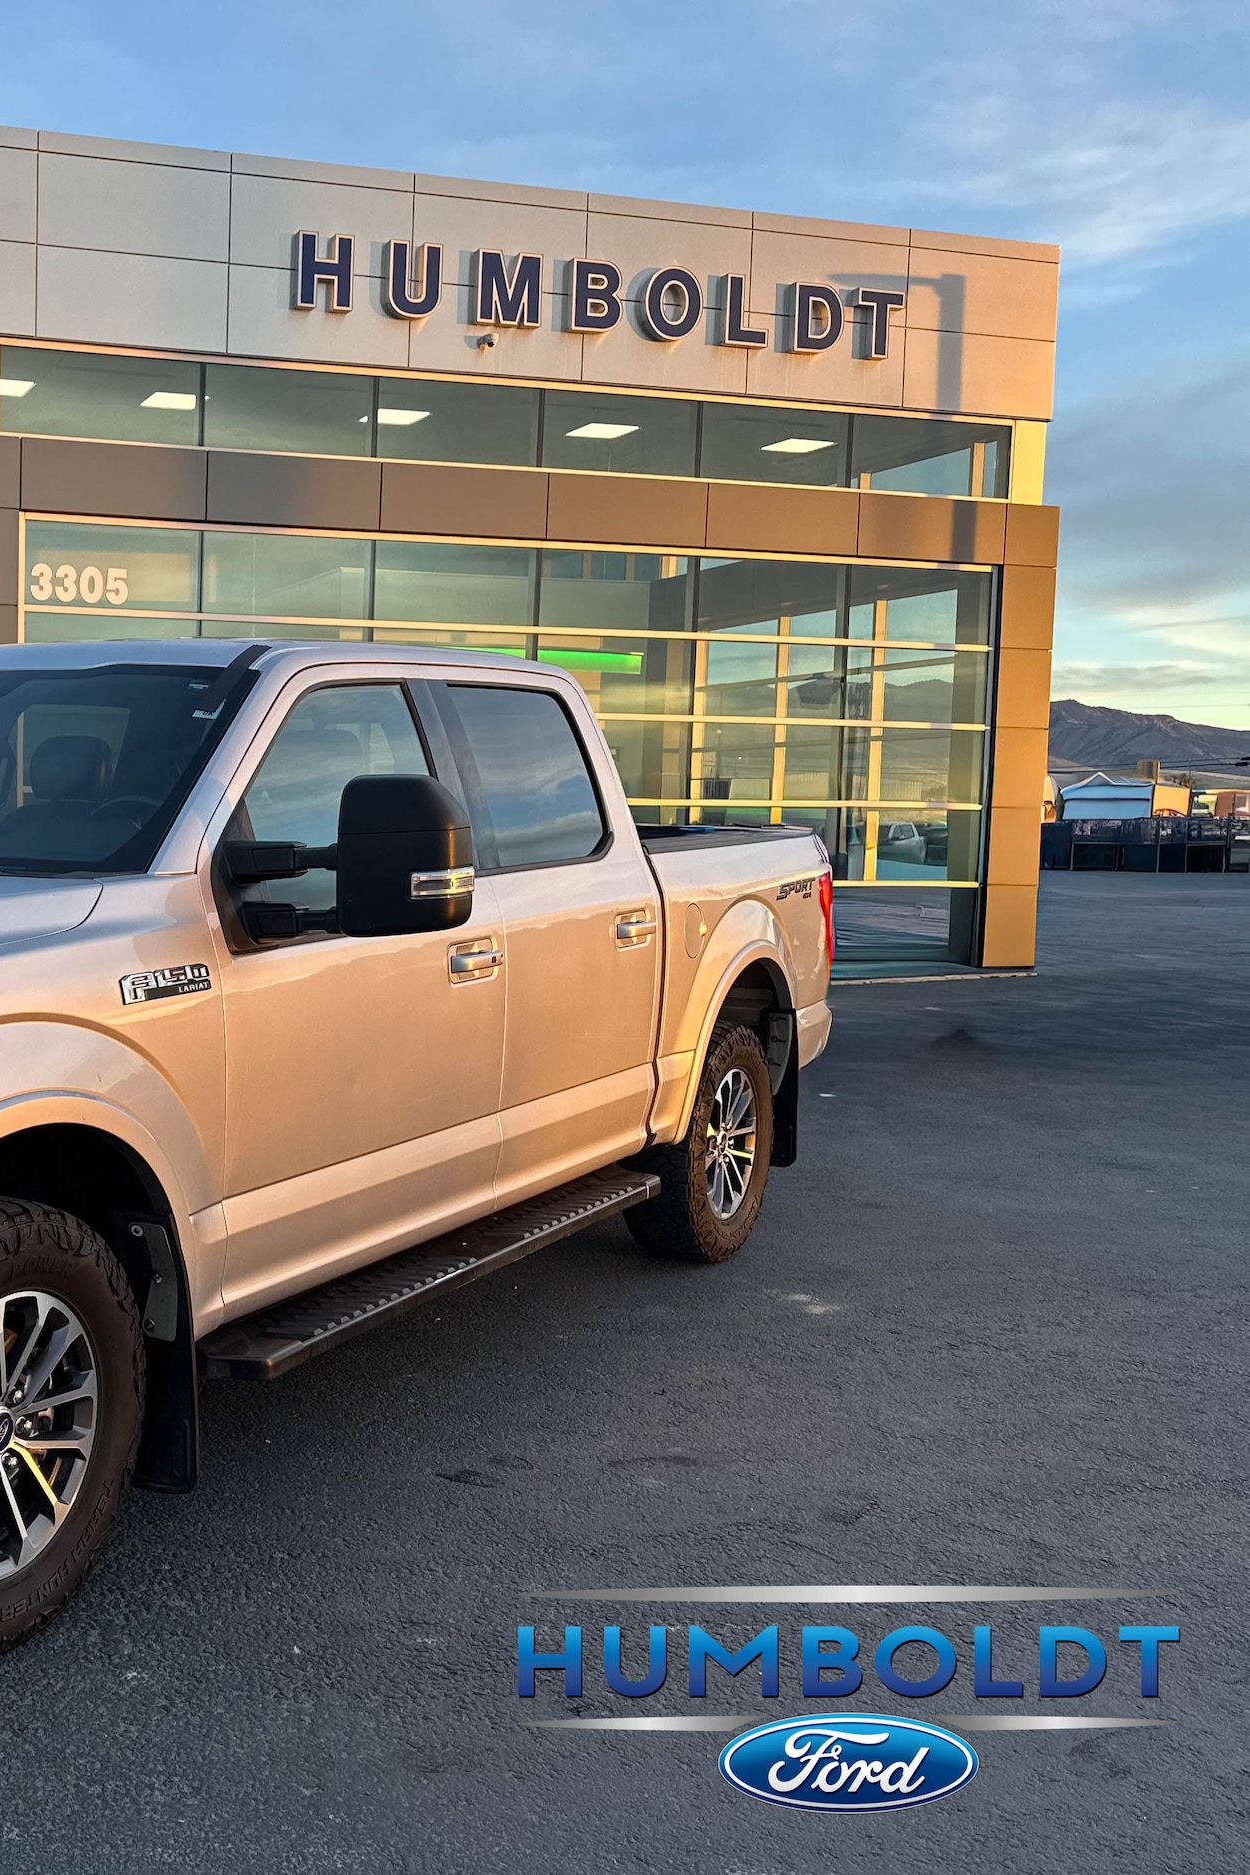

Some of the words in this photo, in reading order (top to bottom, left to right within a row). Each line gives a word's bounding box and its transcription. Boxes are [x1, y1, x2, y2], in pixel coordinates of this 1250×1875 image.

[294, 230, 906, 360] HUMBOLDT
[30, 563, 129, 605] 3305
[776, 877, 816, 901] SPORT
[178, 981, 209, 993] LARIAT
[0, 1559, 71, 1623] HUNTER
